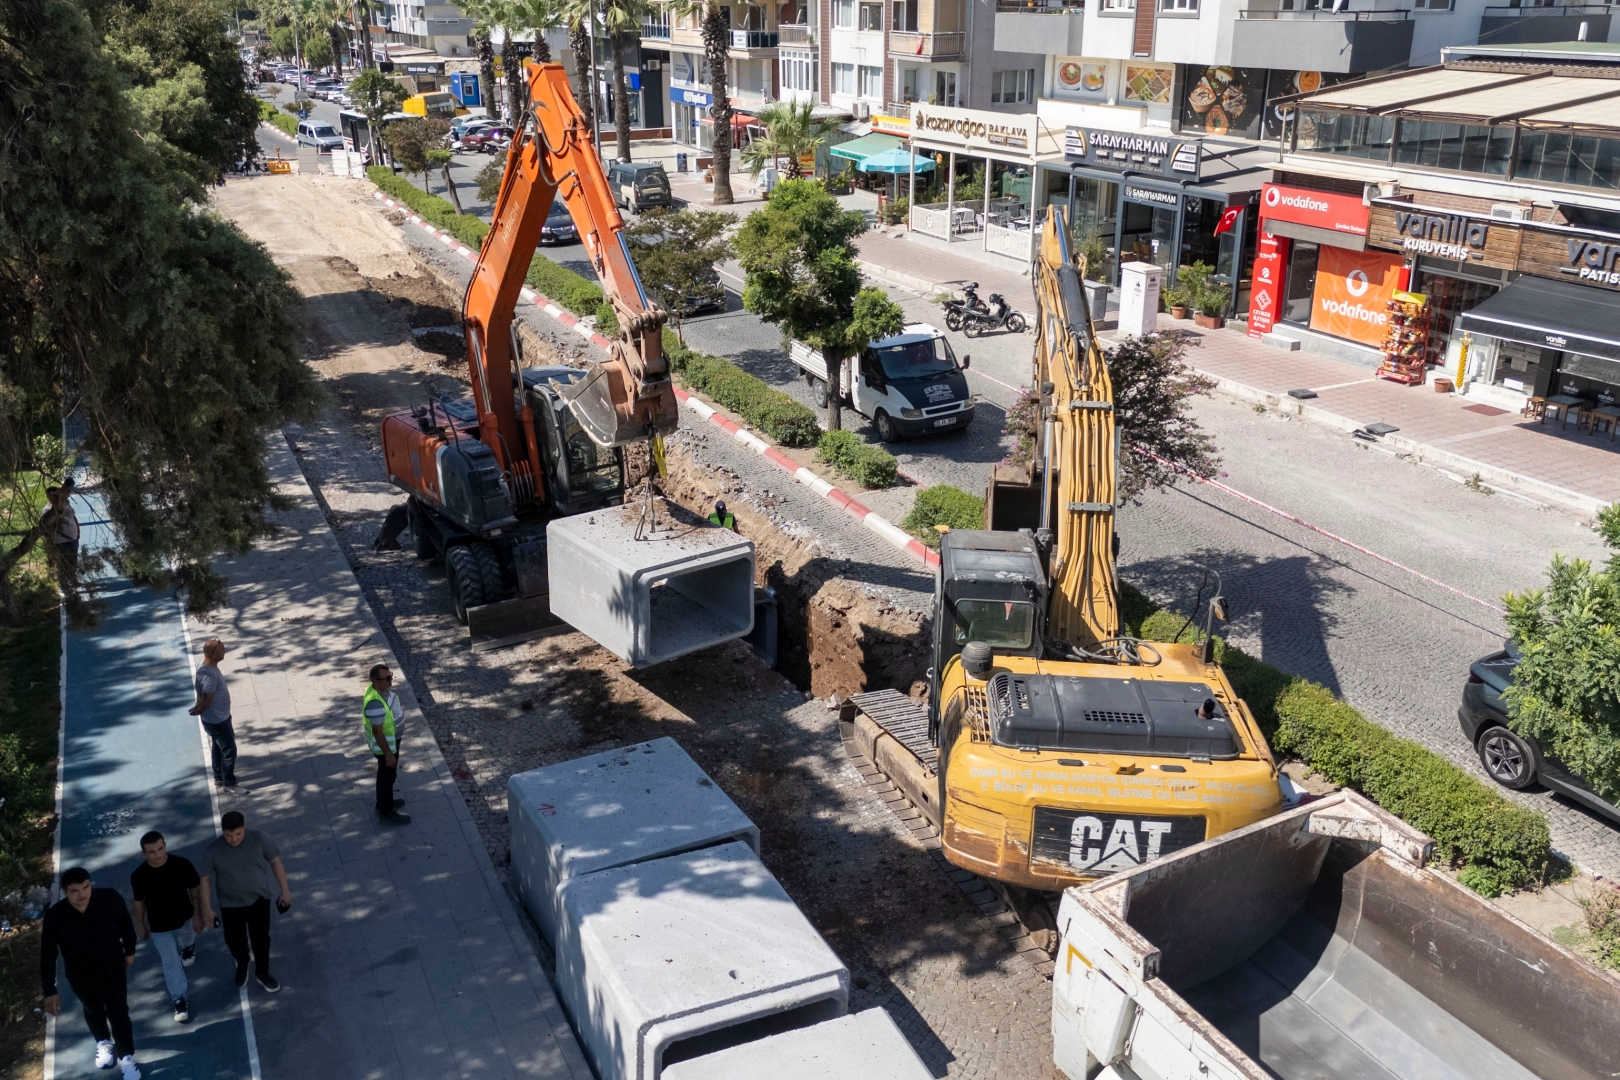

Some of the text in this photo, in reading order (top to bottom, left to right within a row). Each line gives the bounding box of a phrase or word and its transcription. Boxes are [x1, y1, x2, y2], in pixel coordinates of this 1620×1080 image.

[989, 124, 1028, 137] BAKLAVA
[1089, 132, 1168, 154] SARAYHARMAN
[1132, 188, 1177, 204] SARAYHARMAN
[1281, 195, 1329, 212] vodafone
[502, 200, 520, 244] HITACHI
[1394, 211, 1487, 248] vanilla
[1403, 238, 1469, 260] KURUYEMİŞ
[1322, 298, 1387, 326] vodafone
[1545, 335, 1567, 345] vanilla
[1001, 768, 1016, 779] SU
[1019, 769, 1033, 779] VE
[980, 781, 988, 791] 2
[1032, 783, 1048, 793] SU
[1051, 784, 1065, 795] VE
[1068, 785, 1104, 797] KANAL
[1069, 816, 1171, 872] CAT
